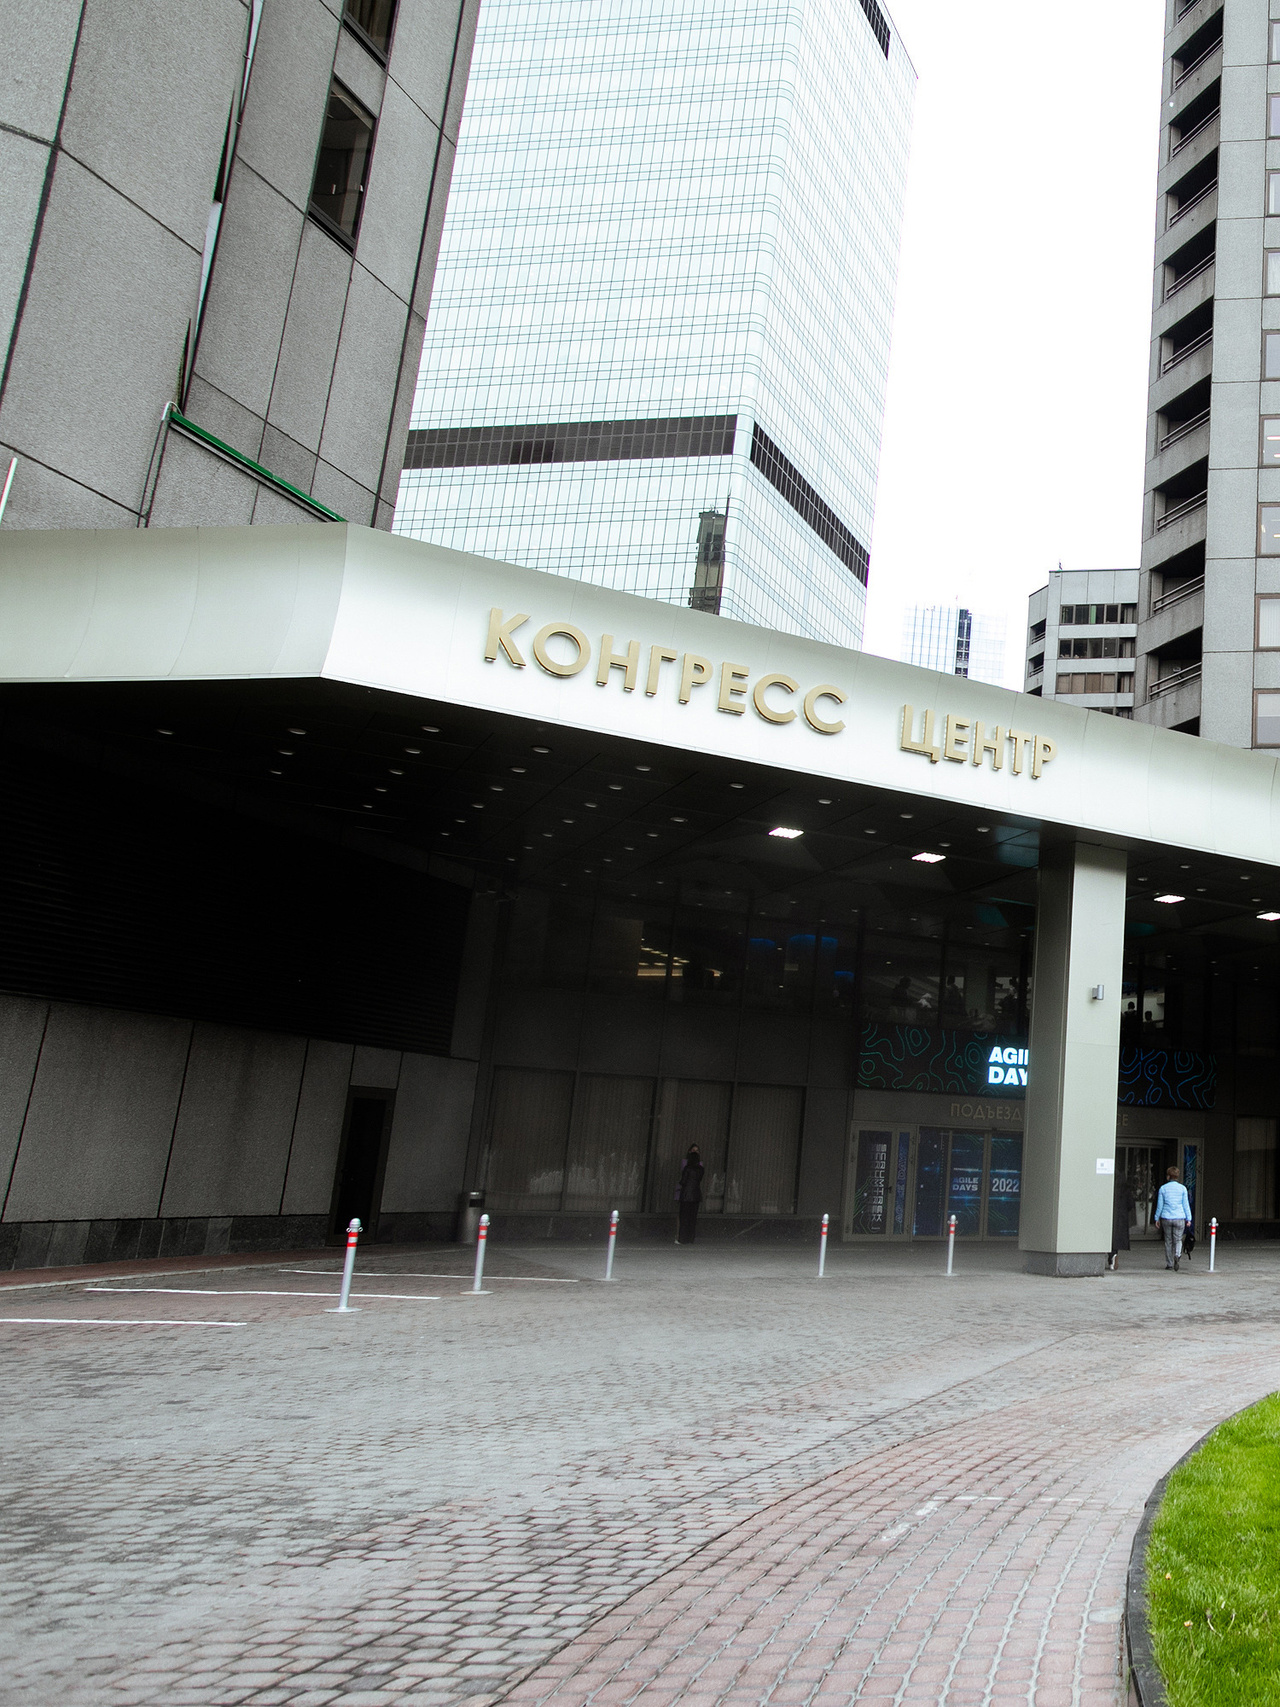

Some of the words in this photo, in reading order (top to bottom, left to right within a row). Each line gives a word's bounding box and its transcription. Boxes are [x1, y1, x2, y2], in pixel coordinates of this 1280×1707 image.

[484, 607, 848, 734] КОНГРЕСС
[900, 704, 1057, 779] ЦЕНТР
[950, 1102, 1023, 1122] ПОДЪЕЗД
[992, 1178, 1020, 1192] 2022
